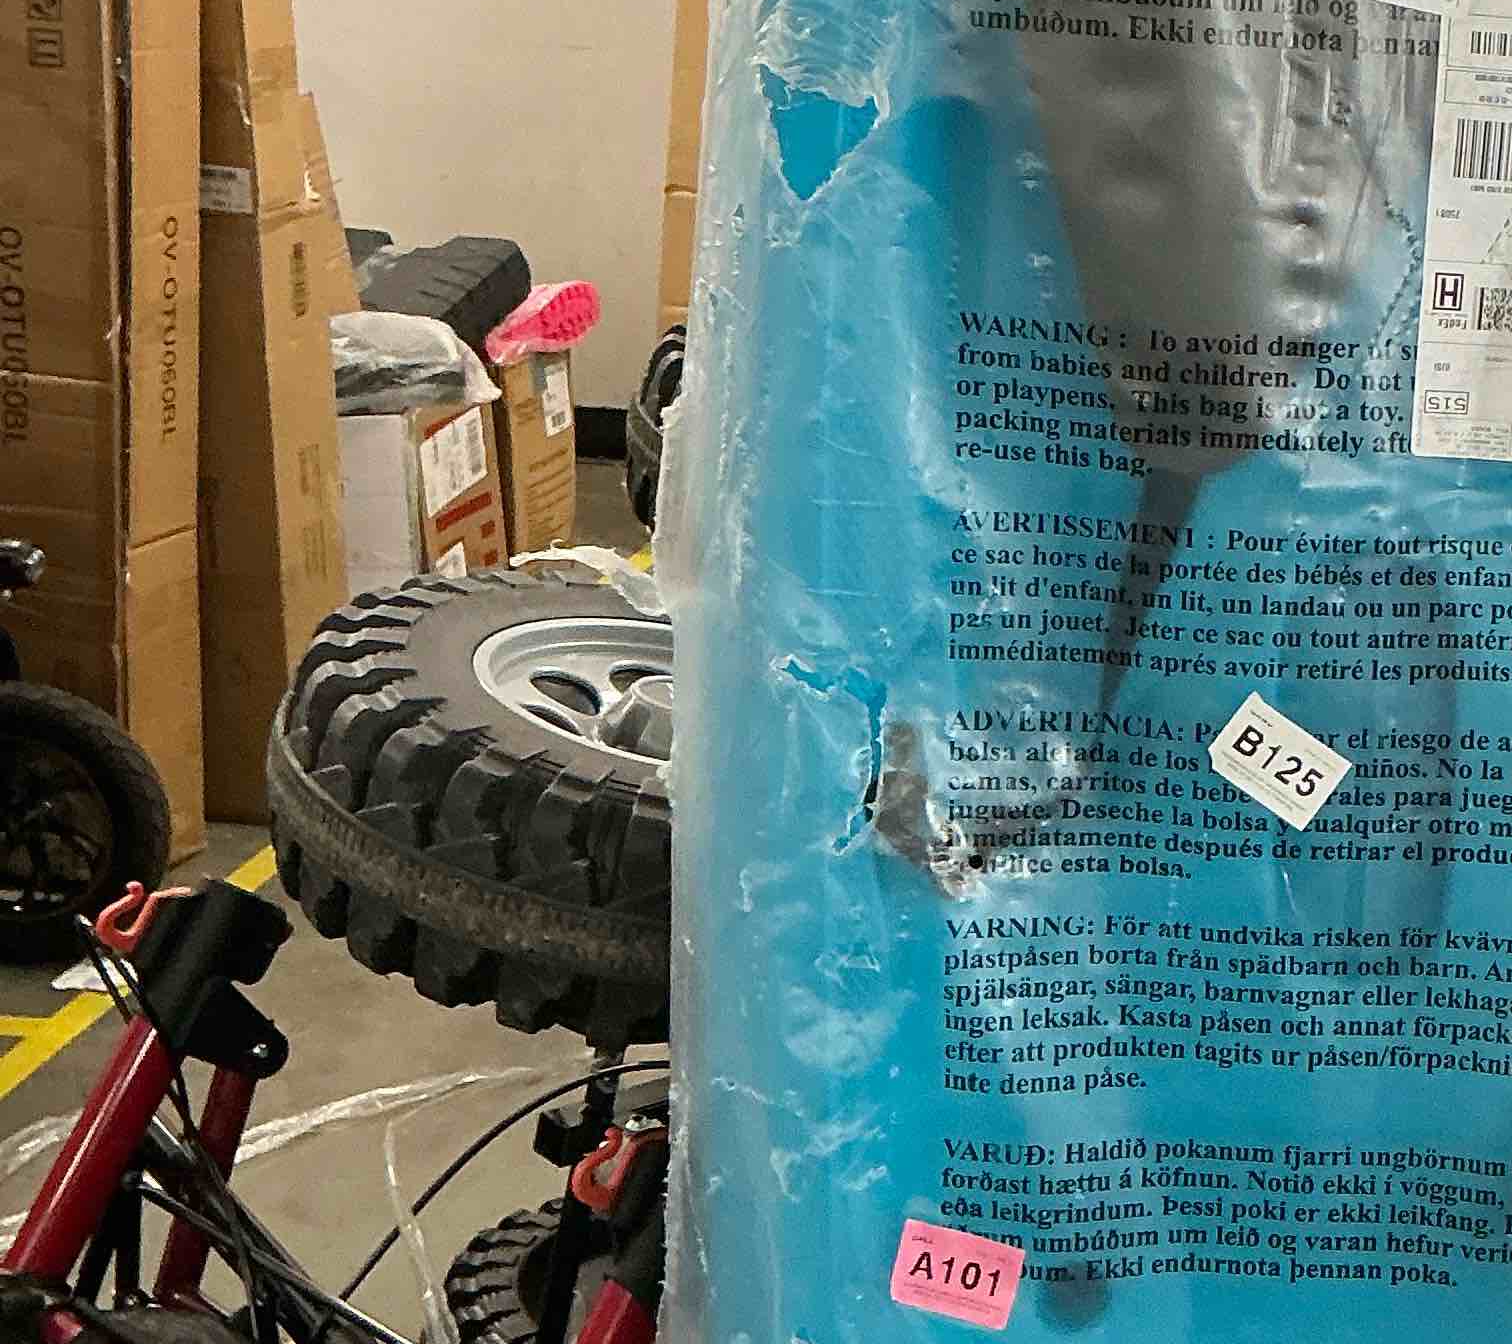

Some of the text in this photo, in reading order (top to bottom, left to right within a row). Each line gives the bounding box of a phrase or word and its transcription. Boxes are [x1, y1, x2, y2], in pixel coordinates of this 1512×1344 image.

[1438, 277, 1460, 307] H
[960, 312, 1359, 361] WARNING danger
[1437, 318, 1468, 330] FedEx
[1179, 364, 1296, 391] children.
[992, 380, 1115, 411] playpens.
[1199, 396, 1248, 424] bag
[1427, 395, 1467, 411] 515
[956, 408, 1191, 448] packing materials
[1228, 528, 1288, 552] Pour
[1295, 532, 1366, 555] éviter
[1160, 558, 1238, 586] portée
[1294, 558, 1365, 586] bébés
[1232, 724, 1325, 797] B125
[1062, 800, 1266, 833] Deseche bolsa
[1165, 838, 1264, 860] después
[1119, 855, 1192, 880] bolsa.
[946, 914, 1095, 940] VARNING:
[1201, 925, 1303, 948] undvika
[944, 944, 1349, 980] plastpåsen borta spädbarn
[1119, 1004, 1192, 1029] Kasta
[1053, 1035, 1185, 1068] produkten
[1085, 1069, 1147, 1091] påse.
[1065, 1139, 1505, 1177] Haldið pokanum ungbörnum
[1141, 1166, 1238, 1191] köfnun.
[1163, 1196, 1495, 1240] Þessi leikfang.
[1388, 1233, 1453, 1256] hefur
[908, 1251, 1001, 1297] A101
[1151, 1256, 1457, 1288] endurnota poka.
